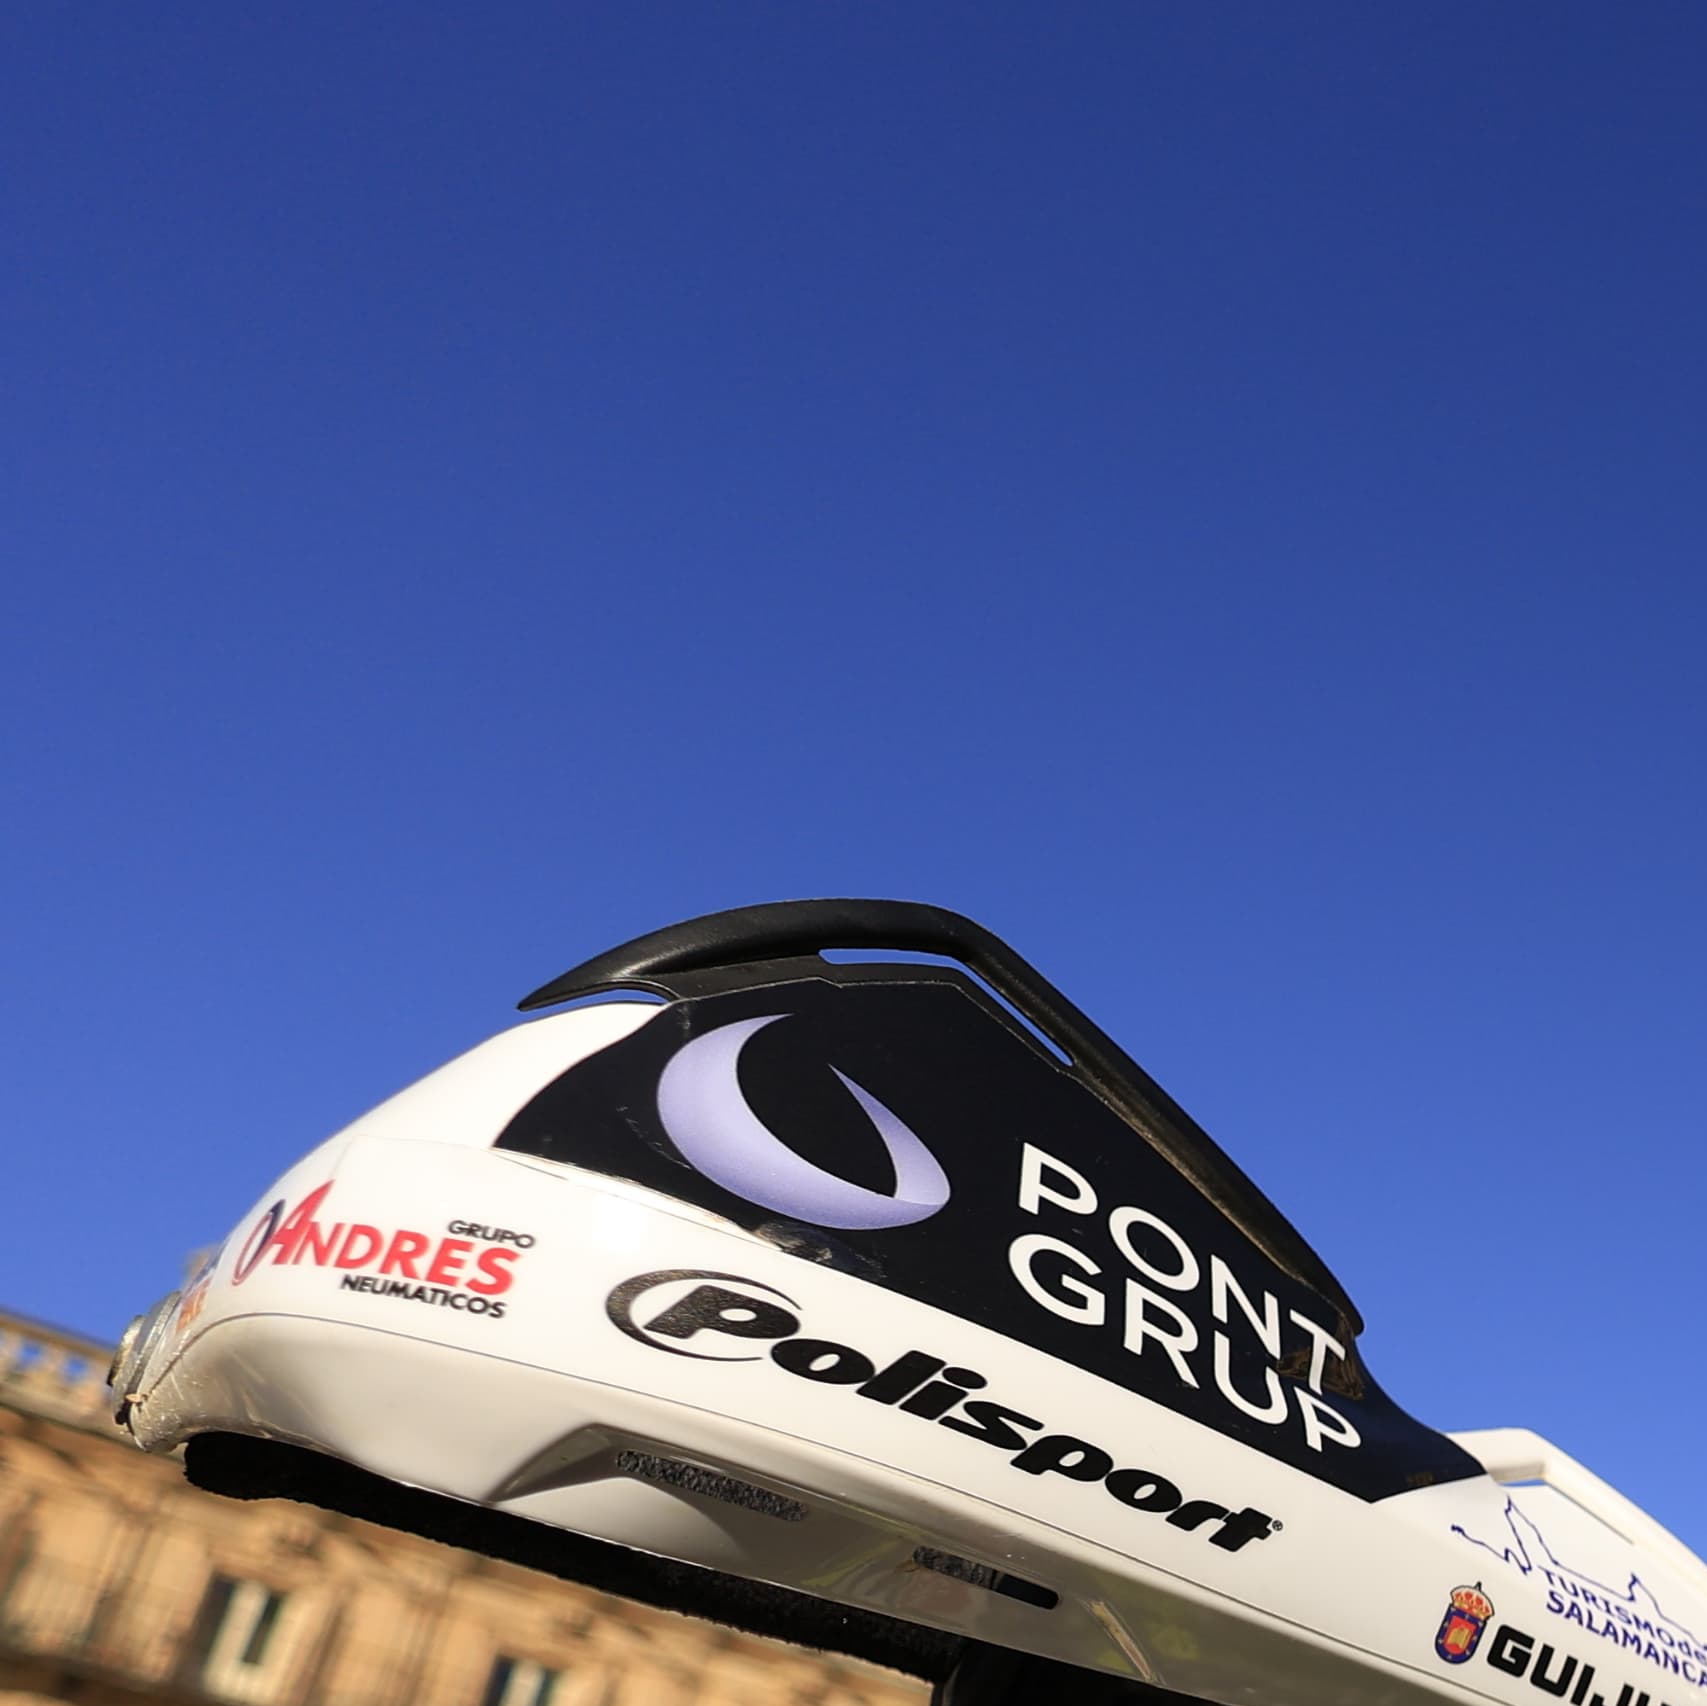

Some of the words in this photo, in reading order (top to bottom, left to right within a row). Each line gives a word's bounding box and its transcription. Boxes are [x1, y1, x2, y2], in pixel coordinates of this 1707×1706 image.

[232, 1179, 522, 1297] ANDRES
[339, 1273, 508, 1319] NEUMATICOS
[447, 1219, 536, 1250] GRUPO
[1018, 1142, 1346, 1396] PONT
[640, 1284, 1276, 1552] Polisport
[1008, 1233, 1362, 1452] GRUP
